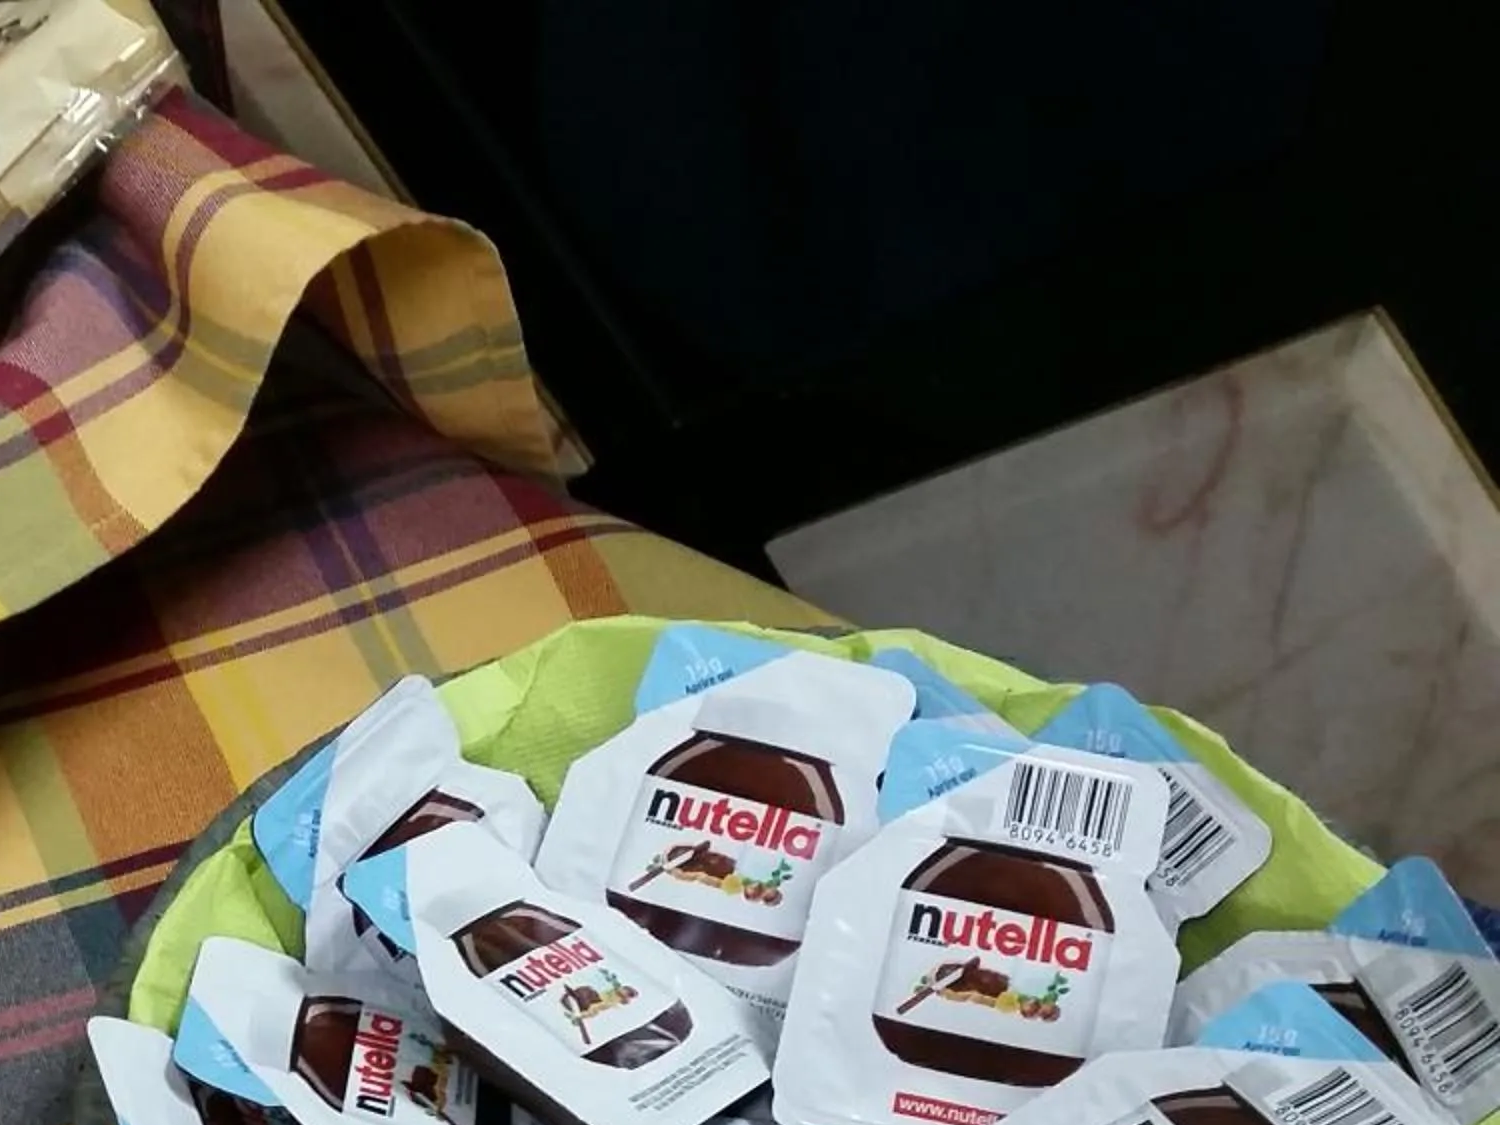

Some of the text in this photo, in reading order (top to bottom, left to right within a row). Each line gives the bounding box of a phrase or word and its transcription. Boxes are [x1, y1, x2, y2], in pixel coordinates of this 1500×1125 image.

[646, 786, 821, 861] nutella
[1008, 824, 1113, 858] 8094 6458
[499, 936, 604, 998] nutella
[908, 902, 1094, 973] nutella
[355, 1011, 403, 1115] nutella
